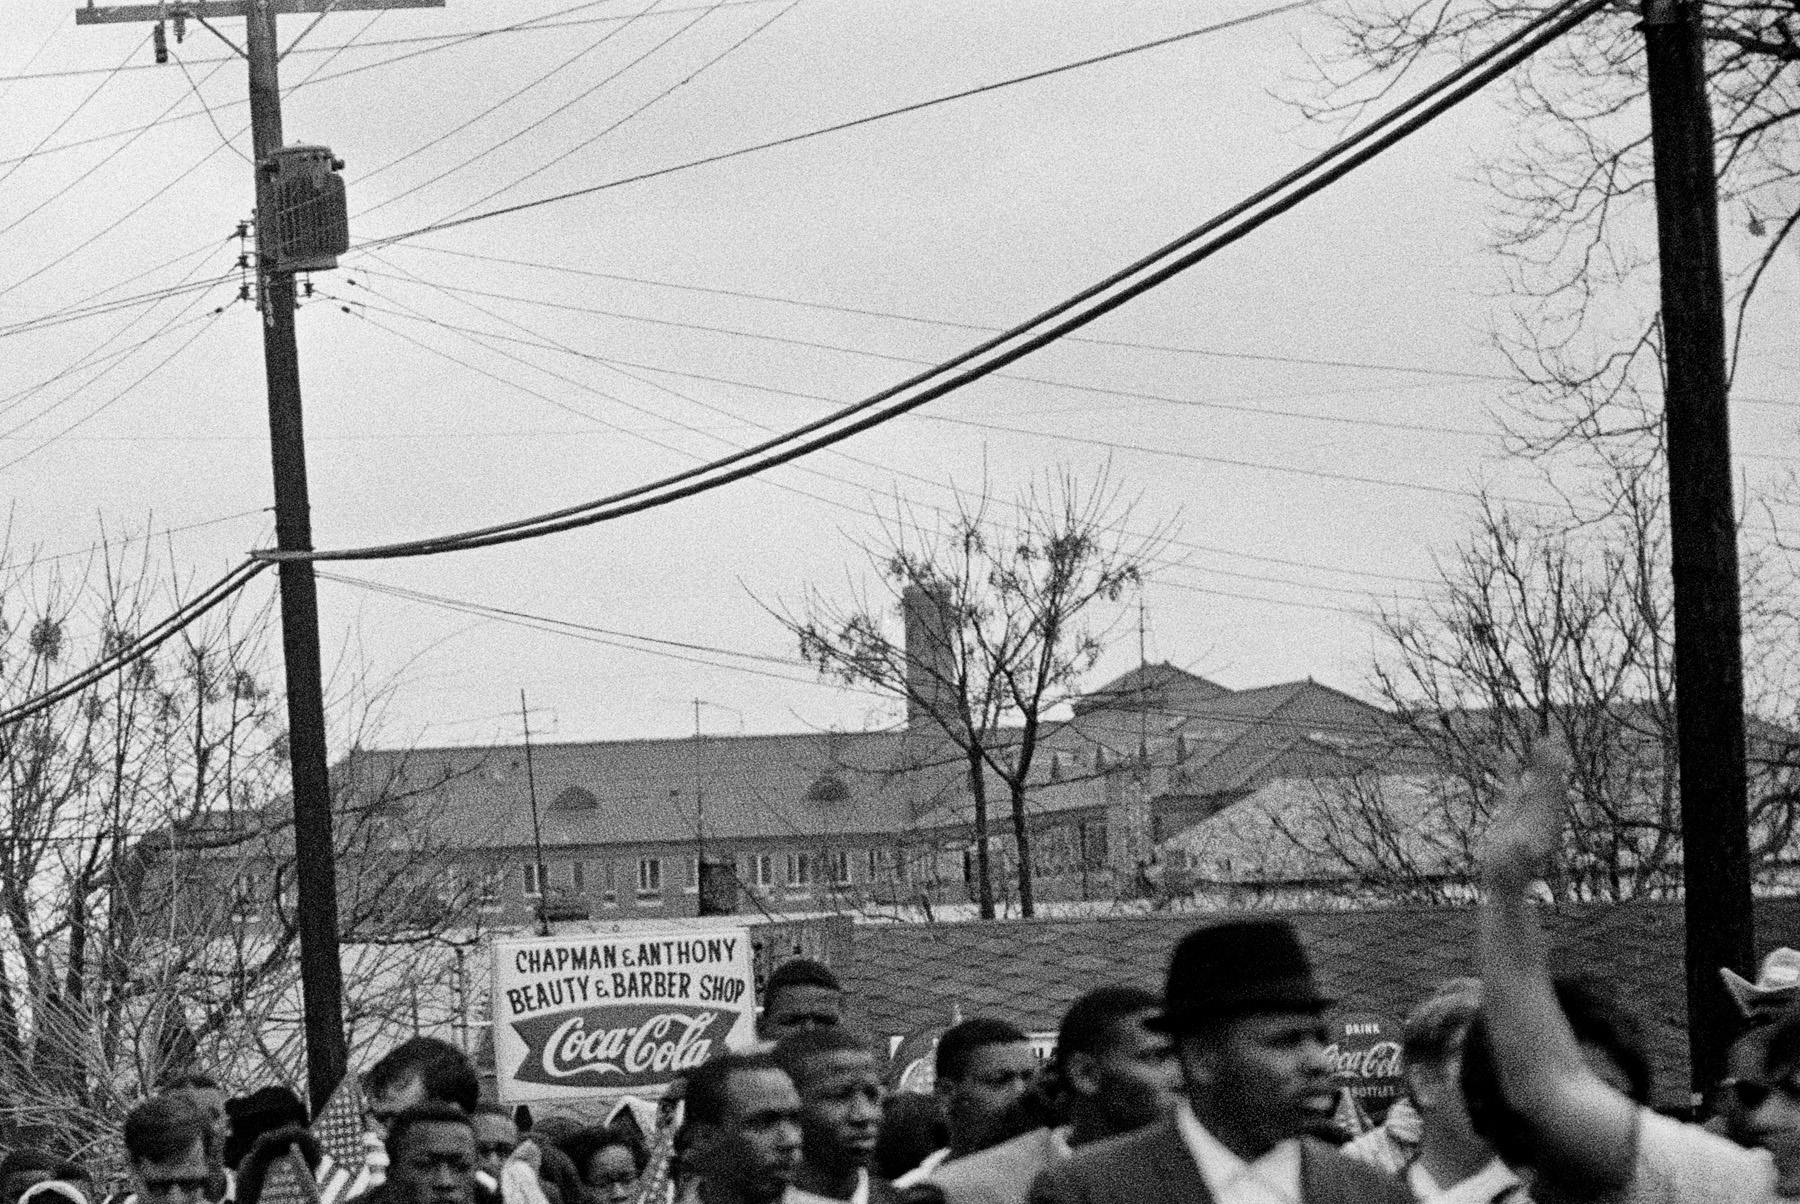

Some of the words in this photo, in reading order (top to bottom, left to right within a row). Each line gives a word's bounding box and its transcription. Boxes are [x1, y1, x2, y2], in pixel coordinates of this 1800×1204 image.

[515, 945, 617, 974] CHAPMAN
[621, 948, 636, 967] &
[638, 937, 737, 967] ANTHONY
[506, 974, 590, 1015] BEAUTY
[595, 979, 611, 998] &
[611, 971, 691, 999] BARBER
[700, 974, 745, 1003] SHOP
[1345, 1023, 1381, 1035] DRINK
